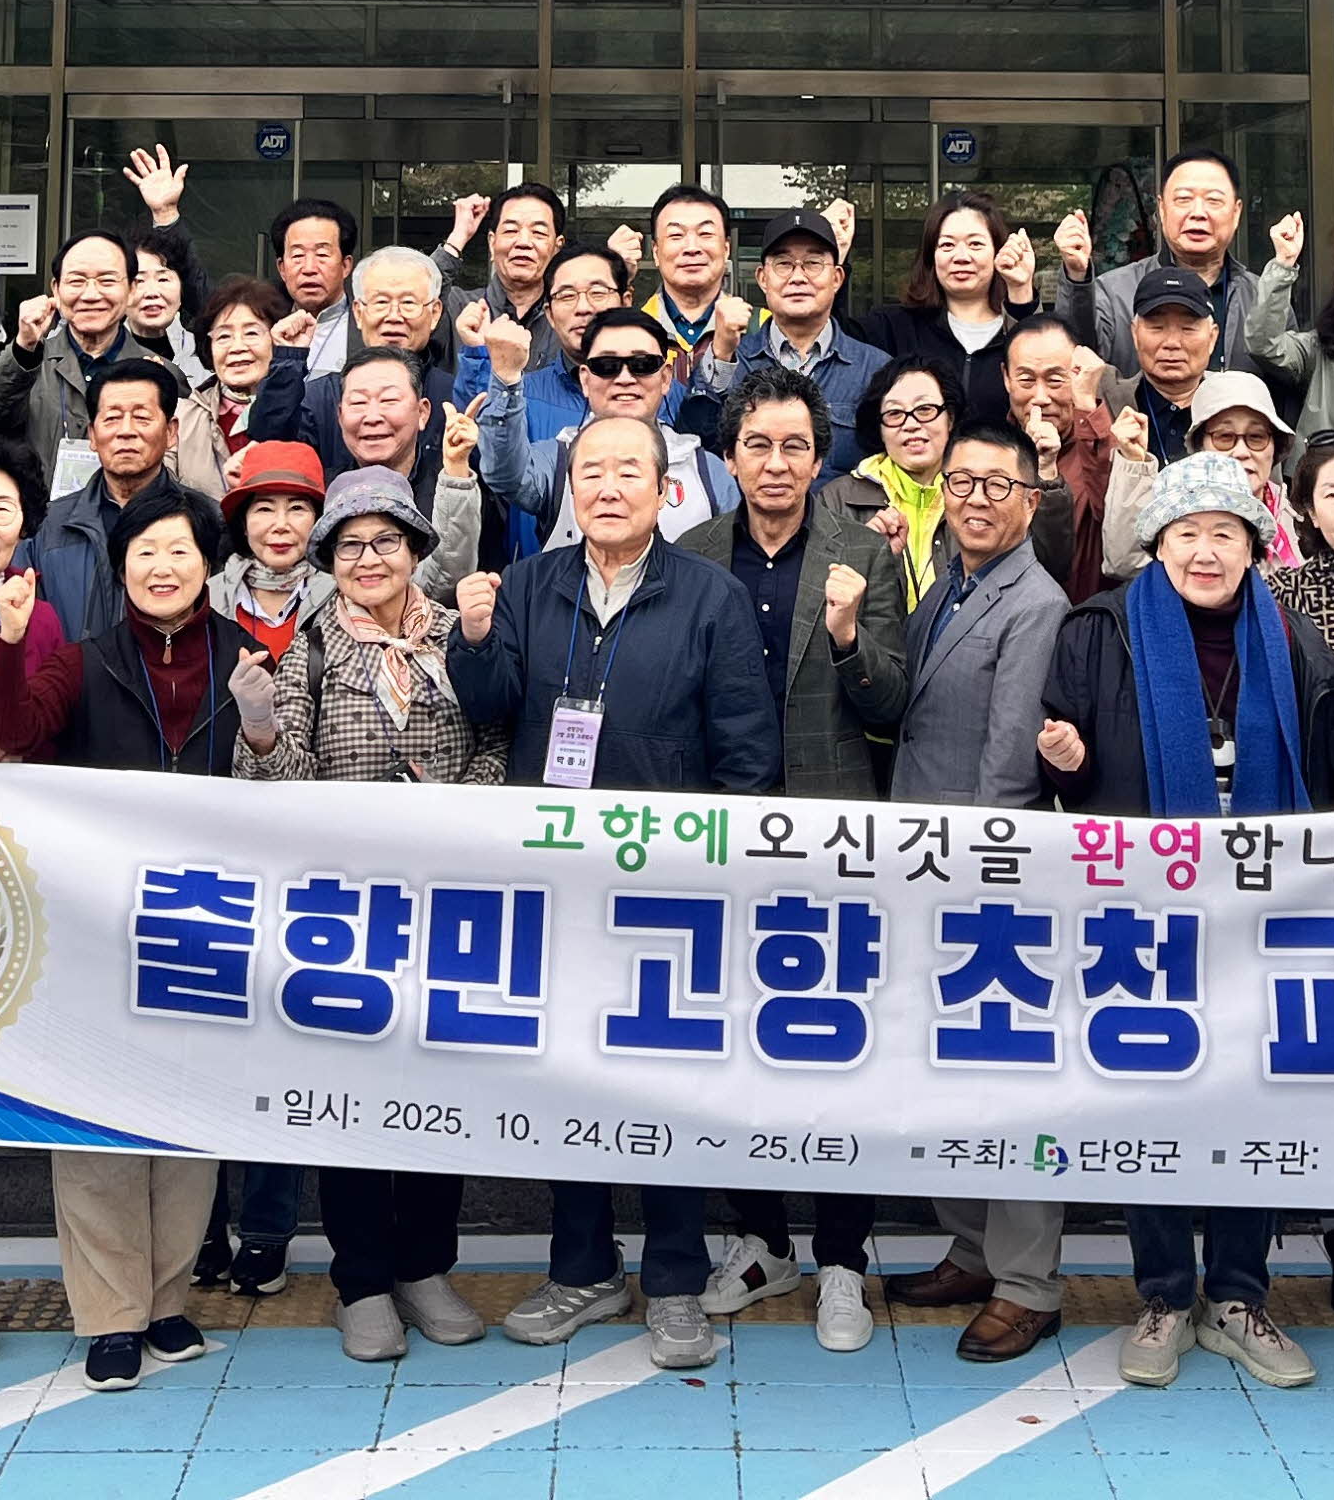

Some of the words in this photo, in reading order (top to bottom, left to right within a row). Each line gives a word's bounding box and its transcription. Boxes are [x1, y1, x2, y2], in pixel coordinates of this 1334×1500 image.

[260, 135, 287, 148] ADT
[946, 140, 972, 154] ADT
[138, 870, 543, 1046] 출향민
[607, 897, 879, 1060] 고향
[938, 905, 1199, 1070] 초청
[284, 1090, 360, 1129] 일시:
[383, 1101, 470, 1138] 2025.
[496, 1113, 539, 1145] 10.
[564, 1119, 672, 1157] 24.(금)
[749, 1133, 858, 1166] 25.(토)
[937, 1139, 1017, 1170] 주최:
[1080, 1139, 1181, 1173] 단양군
[1240, 1140, 1318, 1175] 주관:
